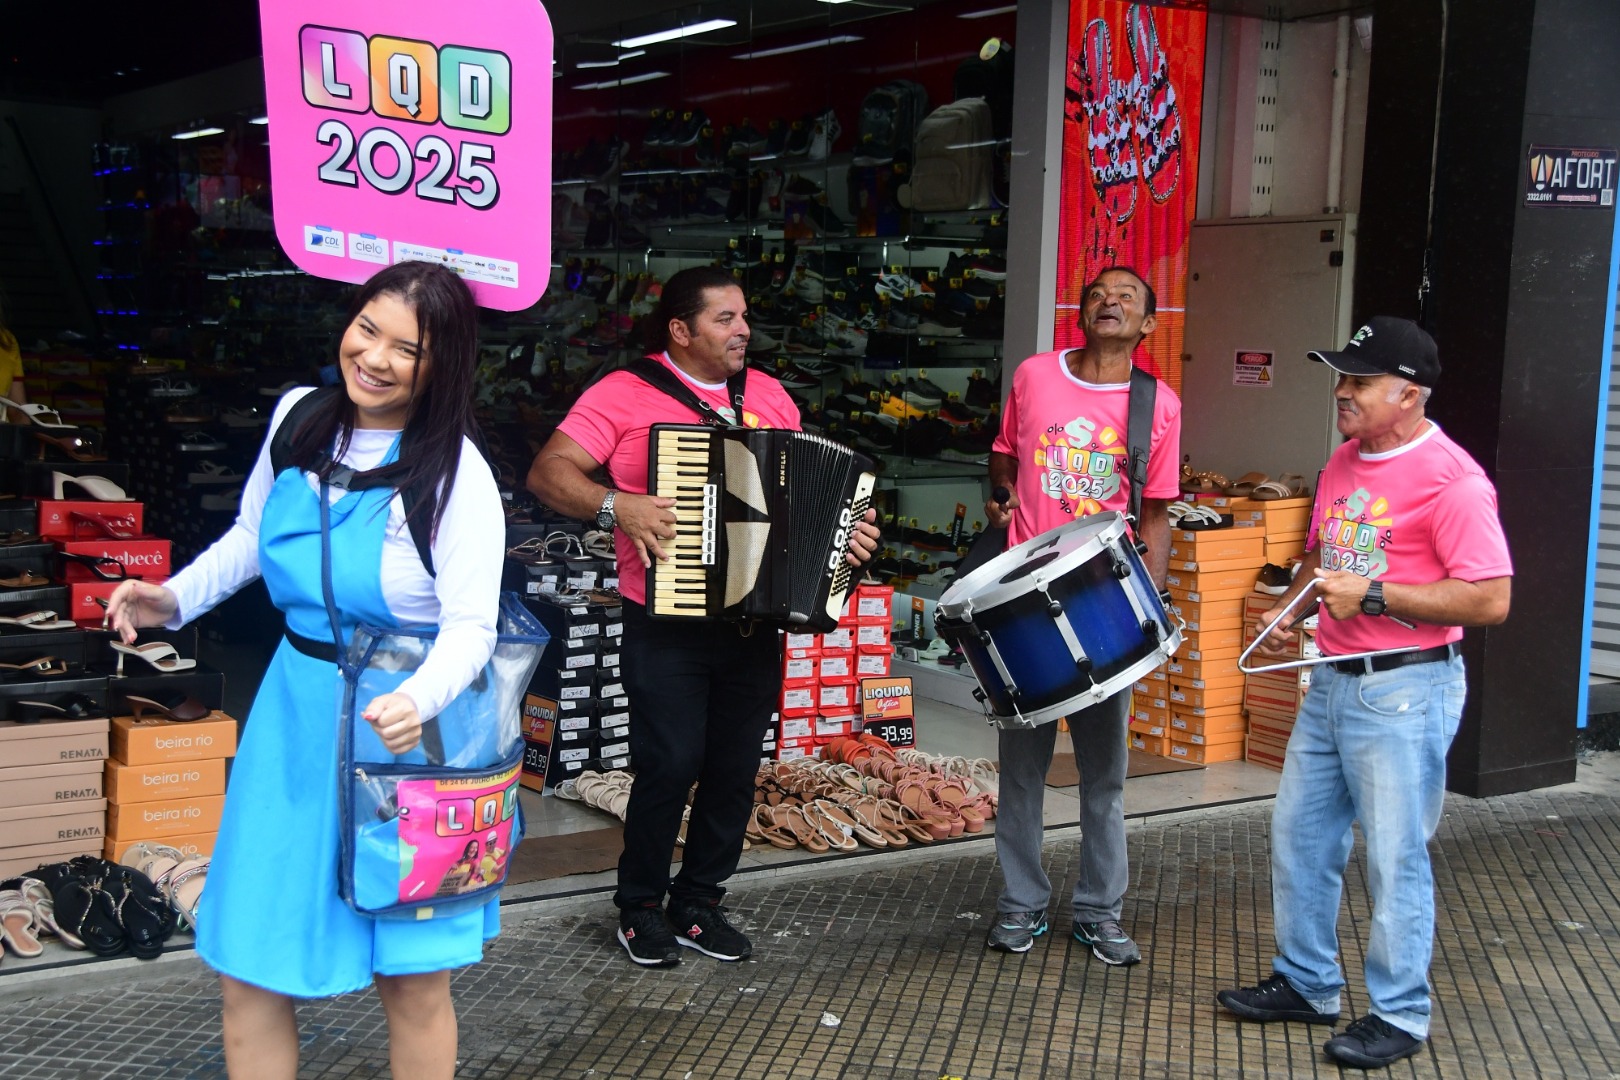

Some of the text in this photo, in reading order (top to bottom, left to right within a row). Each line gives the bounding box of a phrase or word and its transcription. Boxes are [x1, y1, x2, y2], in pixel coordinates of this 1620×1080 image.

[318, 40, 494, 120] LQD
[316, 119, 500, 211] 2025
[324, 236, 340, 247] CDL
[355, 240, 383, 255] cielo
[1052, 448, 1109, 475] LQD
[1049, 470, 1105, 500] 2025
[1327, 521, 1371, 548] LQD
[1323, 546, 1370, 577] 2025
[865, 685, 912, 700] LIQUIDA
[525, 704, 555, 721] LIQUIDA
[155, 734, 213, 749] beira rio
[881, 725, 913, 742] 39,99
[60, 748, 104, 760] RENATA
[526, 748, 547, 769] 39,99
[142, 770, 200, 786] beira rio
[55, 788, 99, 800] RENATA
[143, 806, 201, 822] beira rio
[447, 787, 517, 831] LQD
[58, 827, 101, 839] RENATA
[180, 843, 198, 856] rio
